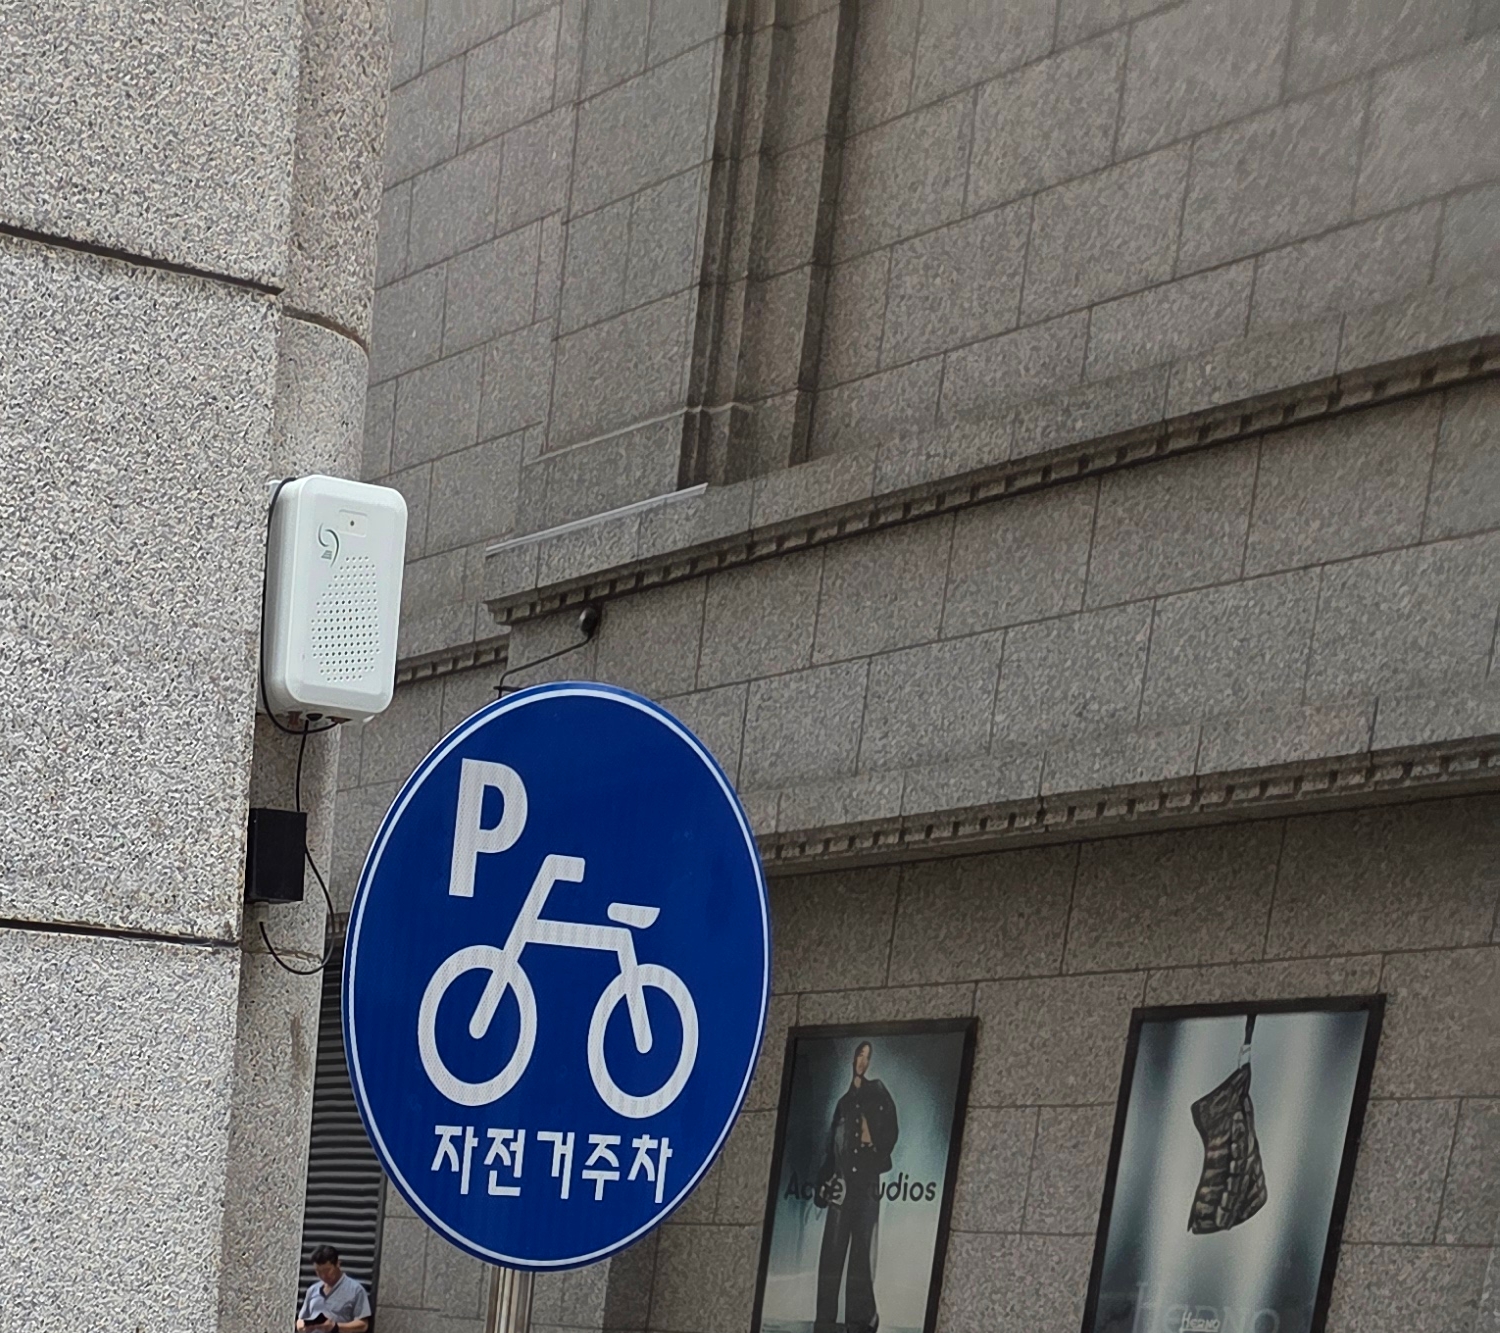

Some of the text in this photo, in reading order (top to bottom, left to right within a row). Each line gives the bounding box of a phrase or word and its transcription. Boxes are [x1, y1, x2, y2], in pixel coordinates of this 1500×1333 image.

[449, 757, 529, 898] P
[430, 1124, 674, 1204] 자전거주차
[784, 1170, 844, 1201] Ace
